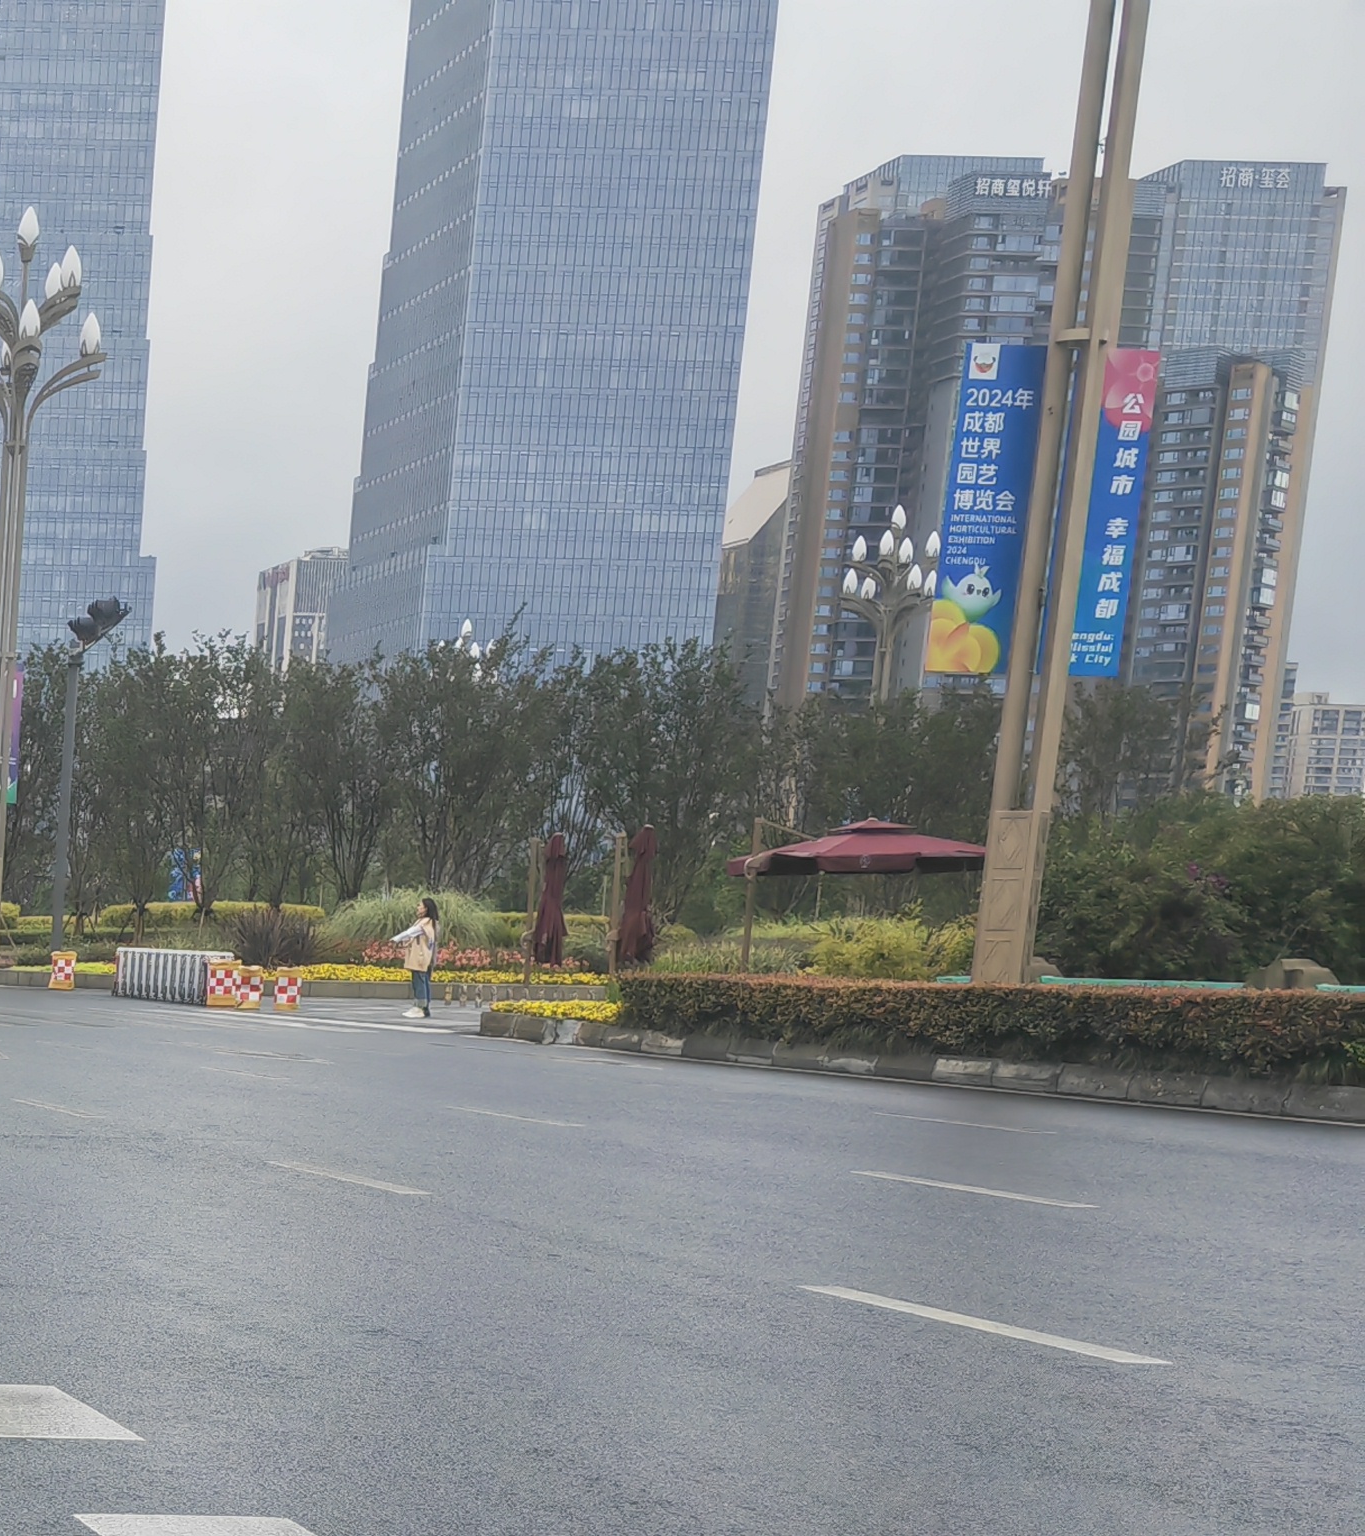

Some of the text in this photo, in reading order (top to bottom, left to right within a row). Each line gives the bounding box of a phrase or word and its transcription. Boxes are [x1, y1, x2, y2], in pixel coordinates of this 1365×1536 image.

[975, 177, 1052, 199] 招商玺悦轩
[965, 387, 1035, 411] 2024年
[962, 411, 1006, 434] 成都
[960, 436, 1001, 459] 世界
[957, 462, 999, 485] 园艺
[953, 488, 1016, 512] 博览会
[1094, 392, 1145, 620] 公园城市 幸福成都
[949, 524, 1017, 535] HORTICULTURAL
[950, 513, 1017, 524] INTERNATIONAL
[946, 545, 967, 555] 2024
[948, 535, 996, 545] EXHIBITION
[945, 556, 986, 566] CHENGDU
[1084, 653, 1111, 667] City
